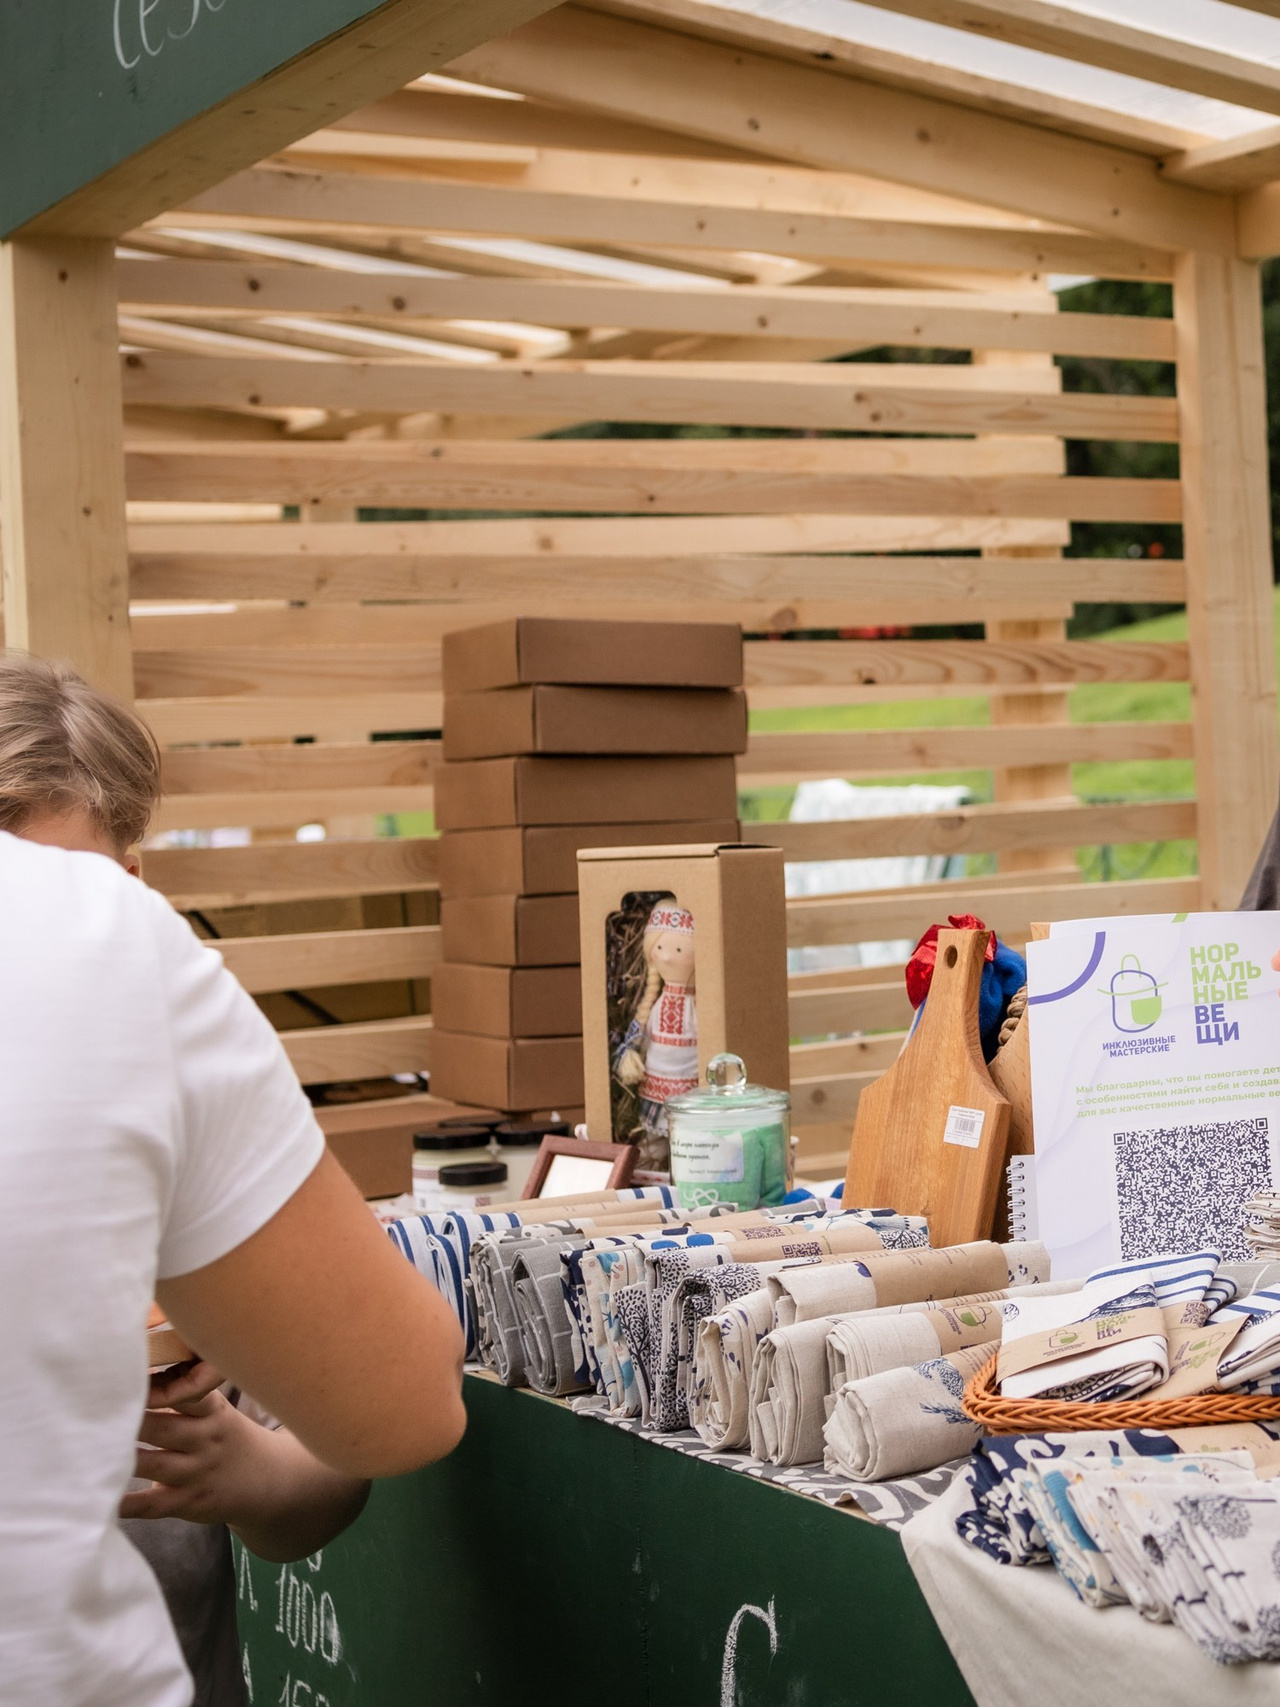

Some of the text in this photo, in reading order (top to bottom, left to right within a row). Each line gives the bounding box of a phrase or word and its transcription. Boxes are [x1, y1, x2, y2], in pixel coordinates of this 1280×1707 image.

[1190, 943, 1239, 965] НОР
[1191, 961, 1262, 985] МАЛЬ
[1193, 981, 1249, 1005] НЫЕ
[1194, 1003, 1225, 1024] ВЕ
[1102, 1035, 1176, 1050] ИНКЛЮЗИВНЫЕ
[1196, 1021, 1239, 1046] ЩИ
[1109, 1044, 1170, 1058] МАСТЕРСКИЕ
[1075, 1085, 1093, 1094] Мы
[1096, 1078, 1163, 1092] благодарны,
[1165, 1076, 1184, 1084] что
[1187, 1074, 1201, 1082] вы
[1204, 1067, 1260, 1080] помогаете
[1077, 1109, 1097, 1118] для
[1099, 1107, 1117, 1116] вас
[1119, 1098, 1195, 1113] качественные
[1198, 1091, 1266, 1105] нормальные
[1085, 1089, 1167, 1105] особенностями
[1170, 1085, 1202, 1096] найти
[1205, 1081, 1229, 1092] себя
